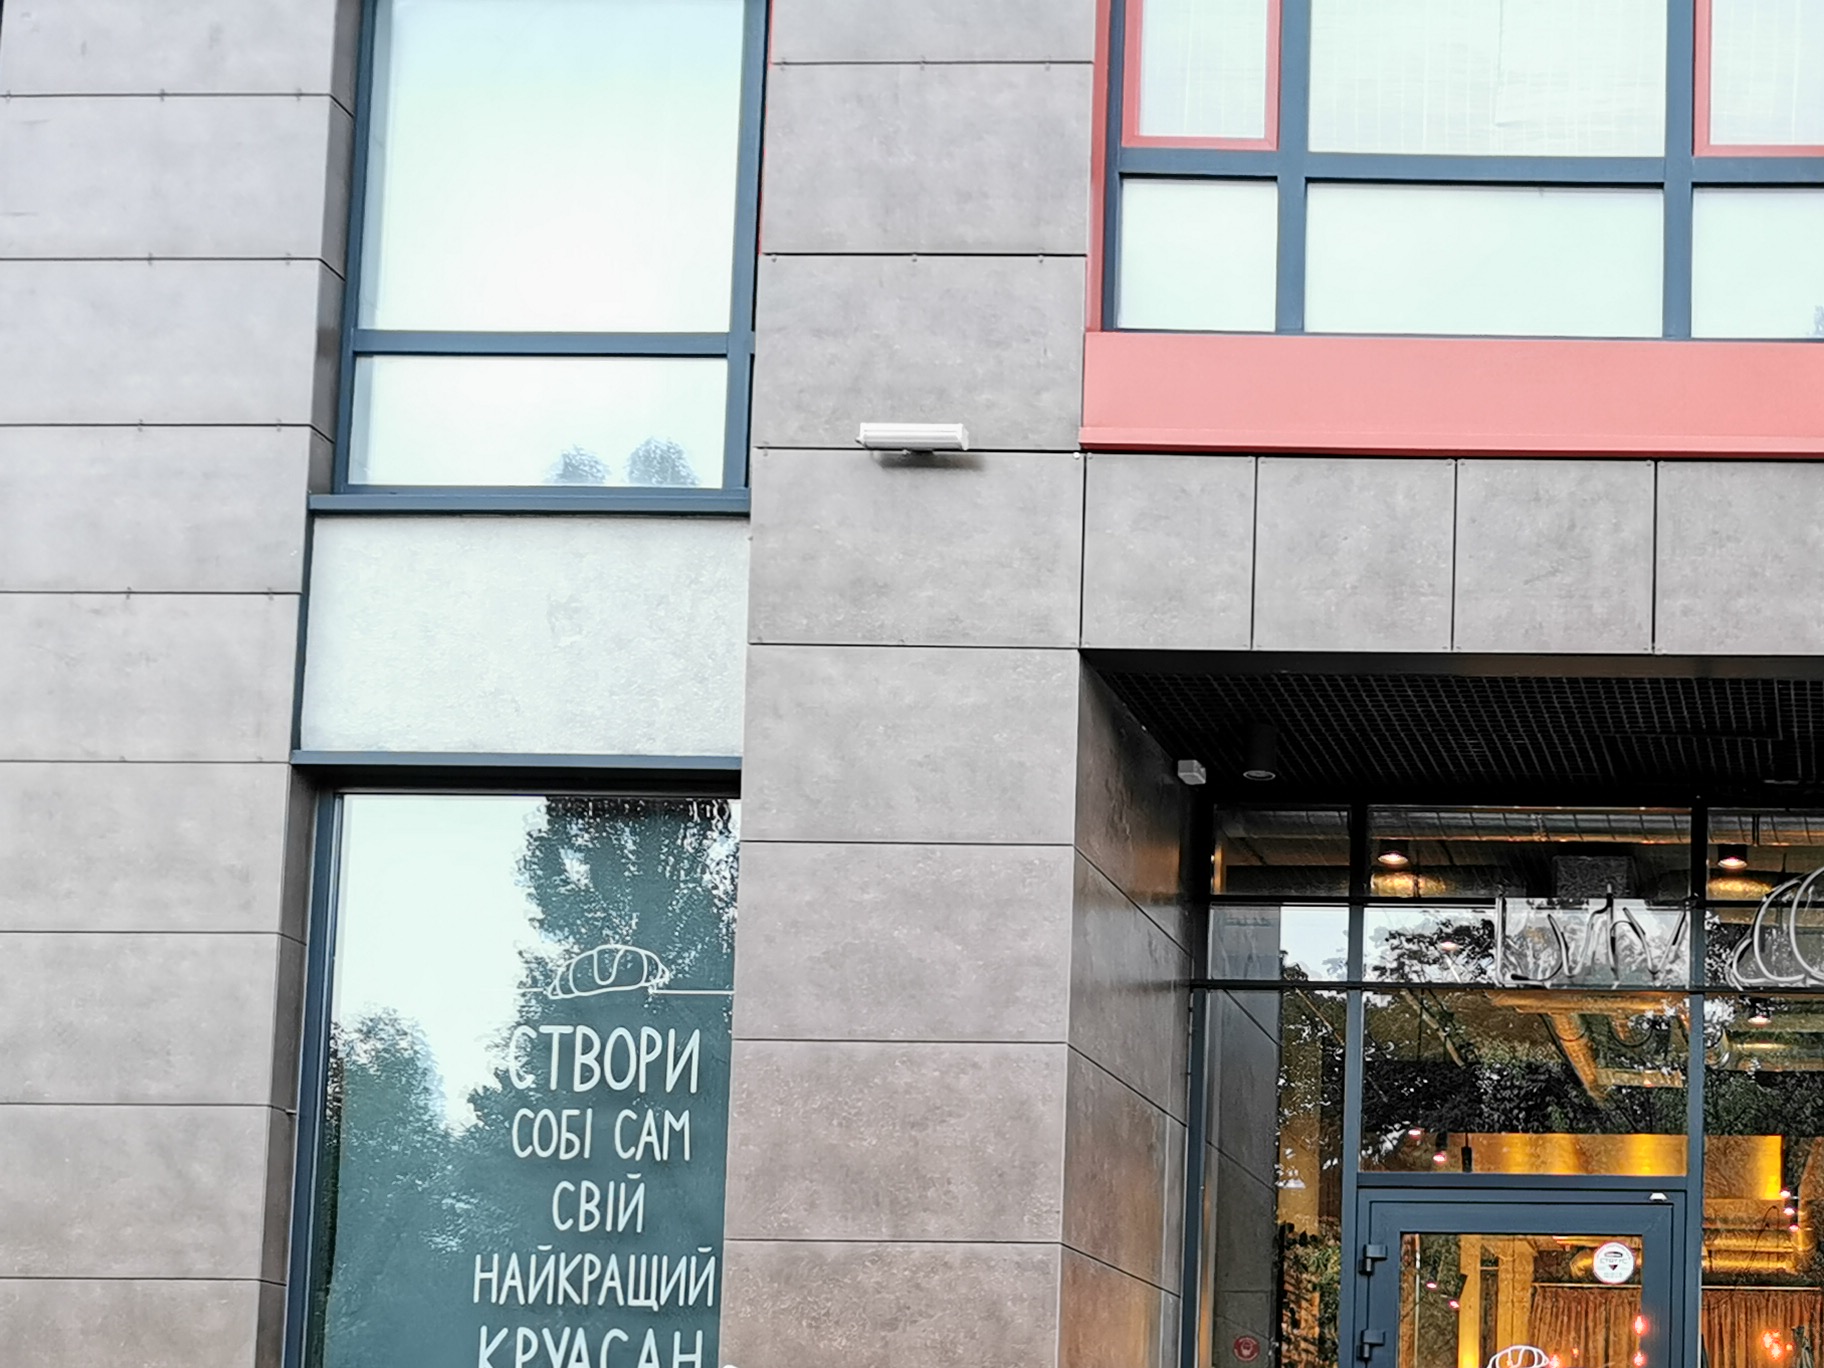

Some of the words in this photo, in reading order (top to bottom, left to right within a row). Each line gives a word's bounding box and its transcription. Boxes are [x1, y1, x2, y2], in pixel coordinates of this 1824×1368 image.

[508, 1025, 701, 1094] СТВОРИ
[511, 1108, 593, 1160] СОБІ
[614, 1108, 690, 1161] САМ
[552, 1173, 646, 1233] СВІЙ
[473, 1244, 717, 1311] НАЙКРАЩИЙ
